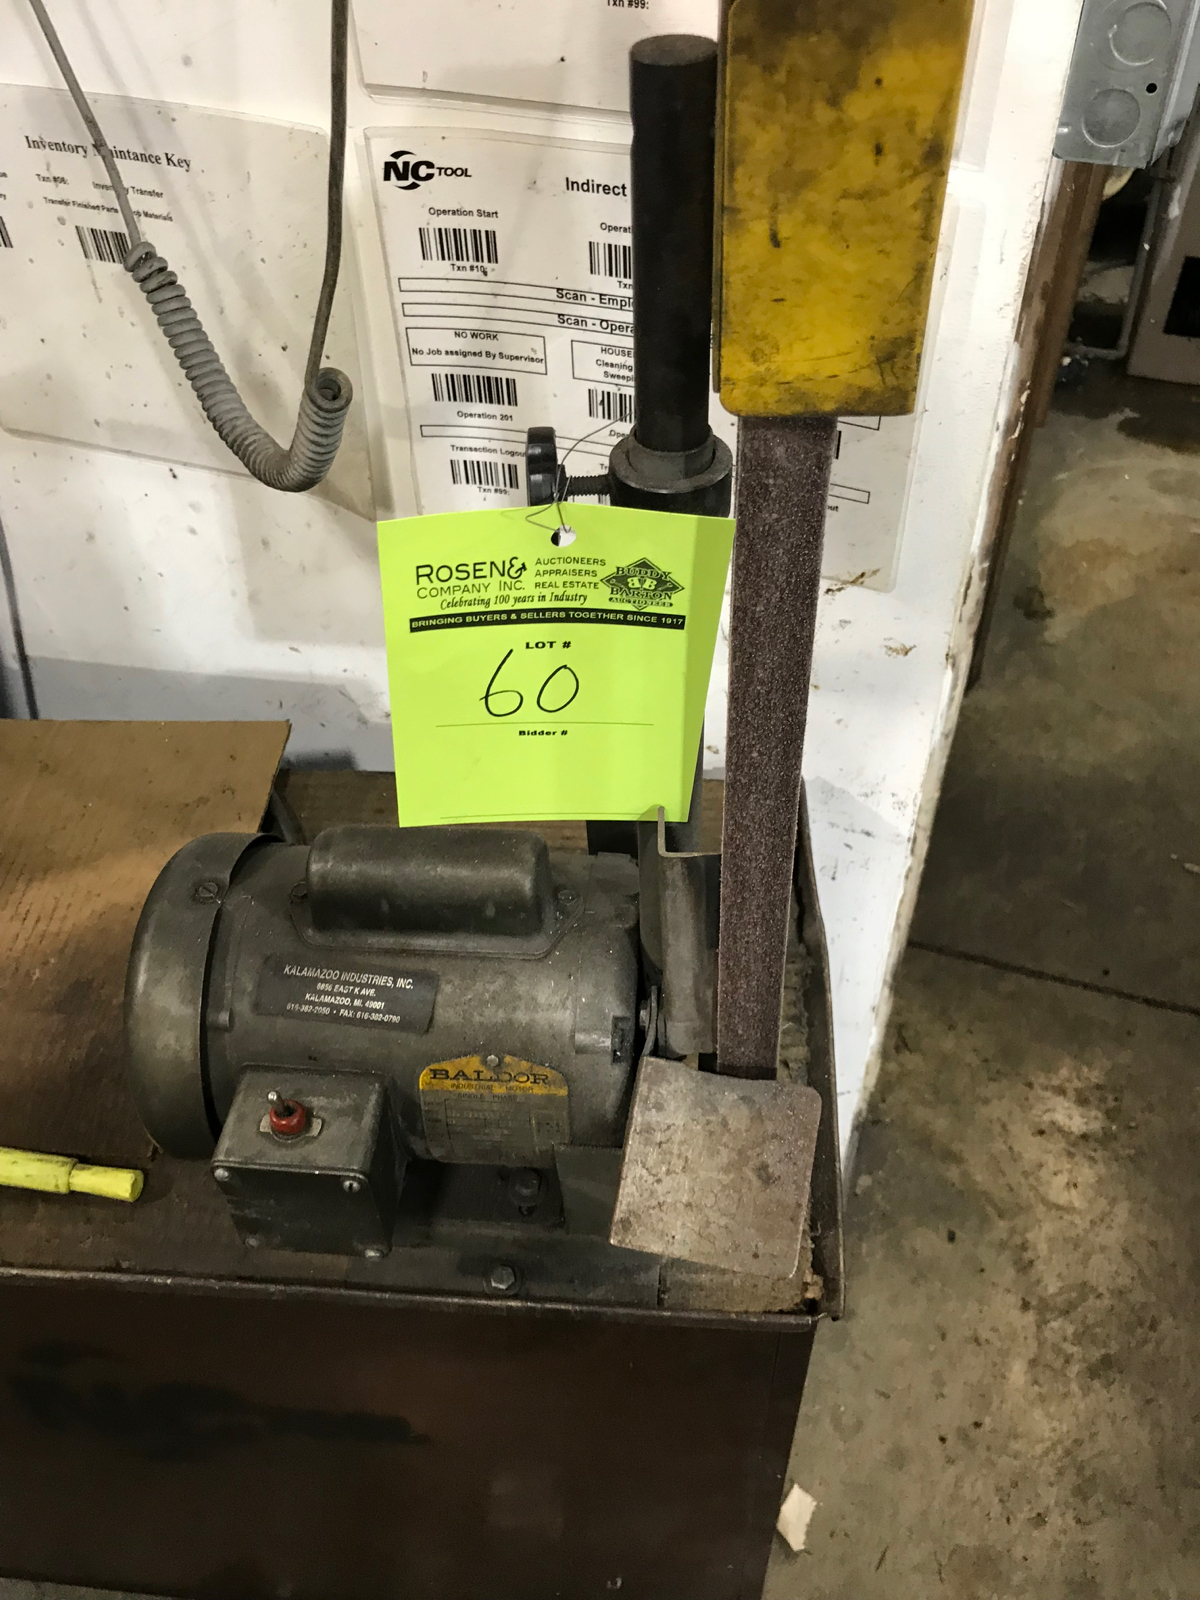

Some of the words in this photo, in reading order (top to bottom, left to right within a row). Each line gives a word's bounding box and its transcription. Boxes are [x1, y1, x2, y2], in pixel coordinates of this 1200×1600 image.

[606, 0, 625, 8] Txn
[627, 0, 650, 9] #99:
[24, 135, 88, 159] Inventory
[91, 142, 162, 165] Mintance
[164, 152, 192, 172] Key
[383, 160, 436, 182] NC
[436, 166, 473, 178] TOOL
[35, 174, 52, 183] Txn
[92, 181, 129, 196] Inveny
[130, 186, 164, 198] Transfer
[565, 176, 628, 198] Indirect
[43, 197, 71, 207] Transfer
[72, 200, 101, 211] Finished
[101, 204, 119, 213] Parts
[142, 210, 174, 222] Materials
[428, 206, 475, 218] Operation
[476, 208, 499, 219] Start
[600, 222, 632, 234] Operat
[450, 263, 467, 272] Txn
[556, 288, 587, 302] Scan
[599, 293, 634, 310] Empl
[557, 313, 588, 328] Scan
[599, 319, 635, 334] Opera
[454, 331, 468, 340] NO
[470, 332, 499, 342] WORK
[411, 347, 424, 357] No
[426, 347, 442, 357] Job
[444, 349, 483, 360] assigned
[485, 351, 497, 360] By
[498, 352, 545, 365] Supervisor
[600, 347, 633, 359] HOUSE
[595, 359, 633, 372] Cleaning
[603, 370, 634, 382] Sweepi
[456, 410, 498, 421] Operation
[500, 413, 514, 422] 201
[450, 444, 498, 455] Transaction
[500, 448, 527, 459] Logou
[477, 486, 492, 494] Txn
[534, 556, 606, 567] AUCTIONEERS
[534, 568, 598, 578] APPRAISERS
[616, 566, 672, 581] BUDDY
[416, 582, 491, 600] COMPANY
[498, 579, 526, 592] INC.
[534, 580, 560, 590] REAL
[562, 580, 600, 590] ESTATE
[610, 586, 673, 601] BARTON
[440, 595, 491, 611] Celebrating
[493, 594, 510, 605] 100
[511, 593, 535, 607] years
[538, 591, 547, 603] in
[549, 590, 588, 606] Industry
[411, 616, 463, 629] BRINGING
[465, 613, 508, 623] BUYERS
[520, 611, 566, 621] SELLERS
[568, 611, 624, 622] TOGETHER
[626, 613, 658, 624] SINCE
[661, 616, 684, 626] 1917
[525, 641, 557, 650] LOT
[562, 641, 572, 649] #
[479, 649, 580, 718] 60
[518, 729, 560, 737] Bidder
[283, 964, 340, 980] KALAMAZOO
[340, 971, 395, 989] INDUSTRIES,
[395, 977, 414, 990] INC.
[333, 984, 353, 994] EAST
[354, 986, 360, 995] K
[360, 987, 377, 997] AVE.
[305, 993, 352, 1006] KALAMAZOO,
[365, 1000, 385, 1010] 49001
[339, 1008, 356, 1018] FAX:
[429, 1068, 549, 1085] BALDOR
